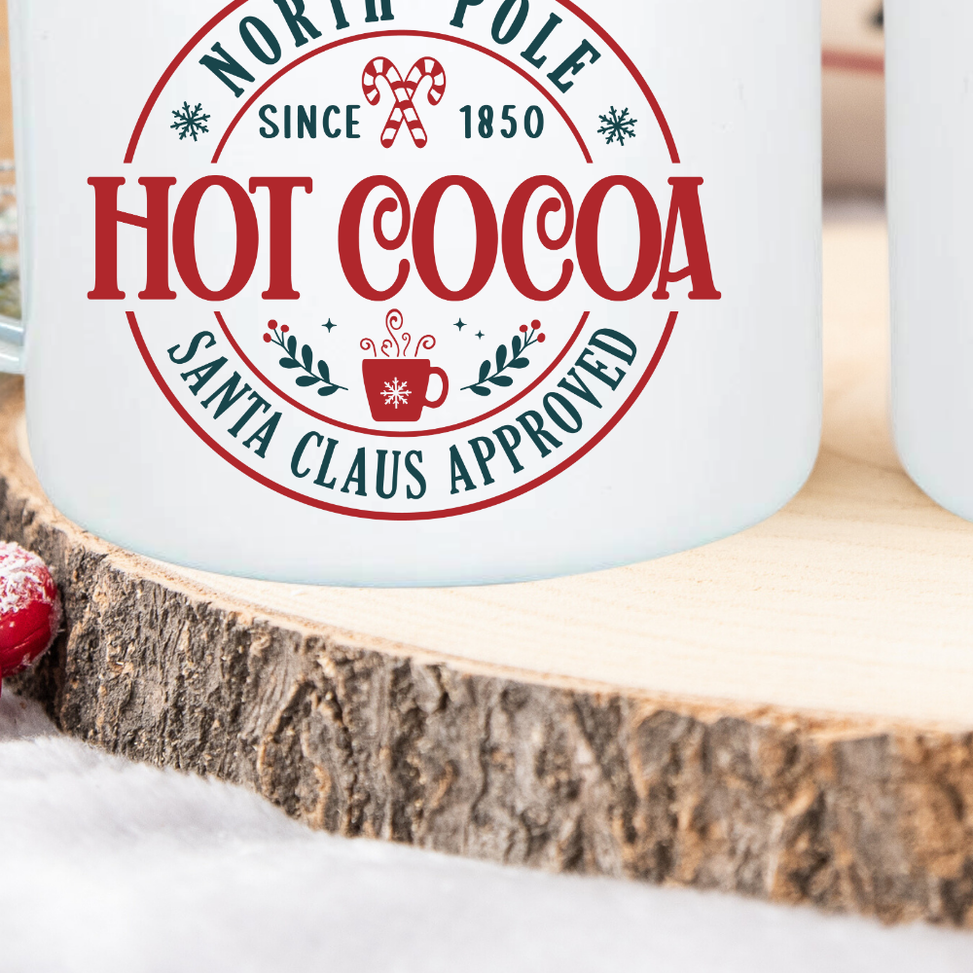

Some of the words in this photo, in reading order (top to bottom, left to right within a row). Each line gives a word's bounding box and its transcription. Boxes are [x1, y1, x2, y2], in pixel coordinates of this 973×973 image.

[259, 104, 361, 139] SINCE
[459, 104, 544, 139] 1850
[87, 175, 312, 301] HOT
[338, 175, 721, 301] COCOA
[167, 330, 282, 459] SANTA
[291, 431, 427, 500] CLAUS
[450, 328, 638, 494] APPROVED
